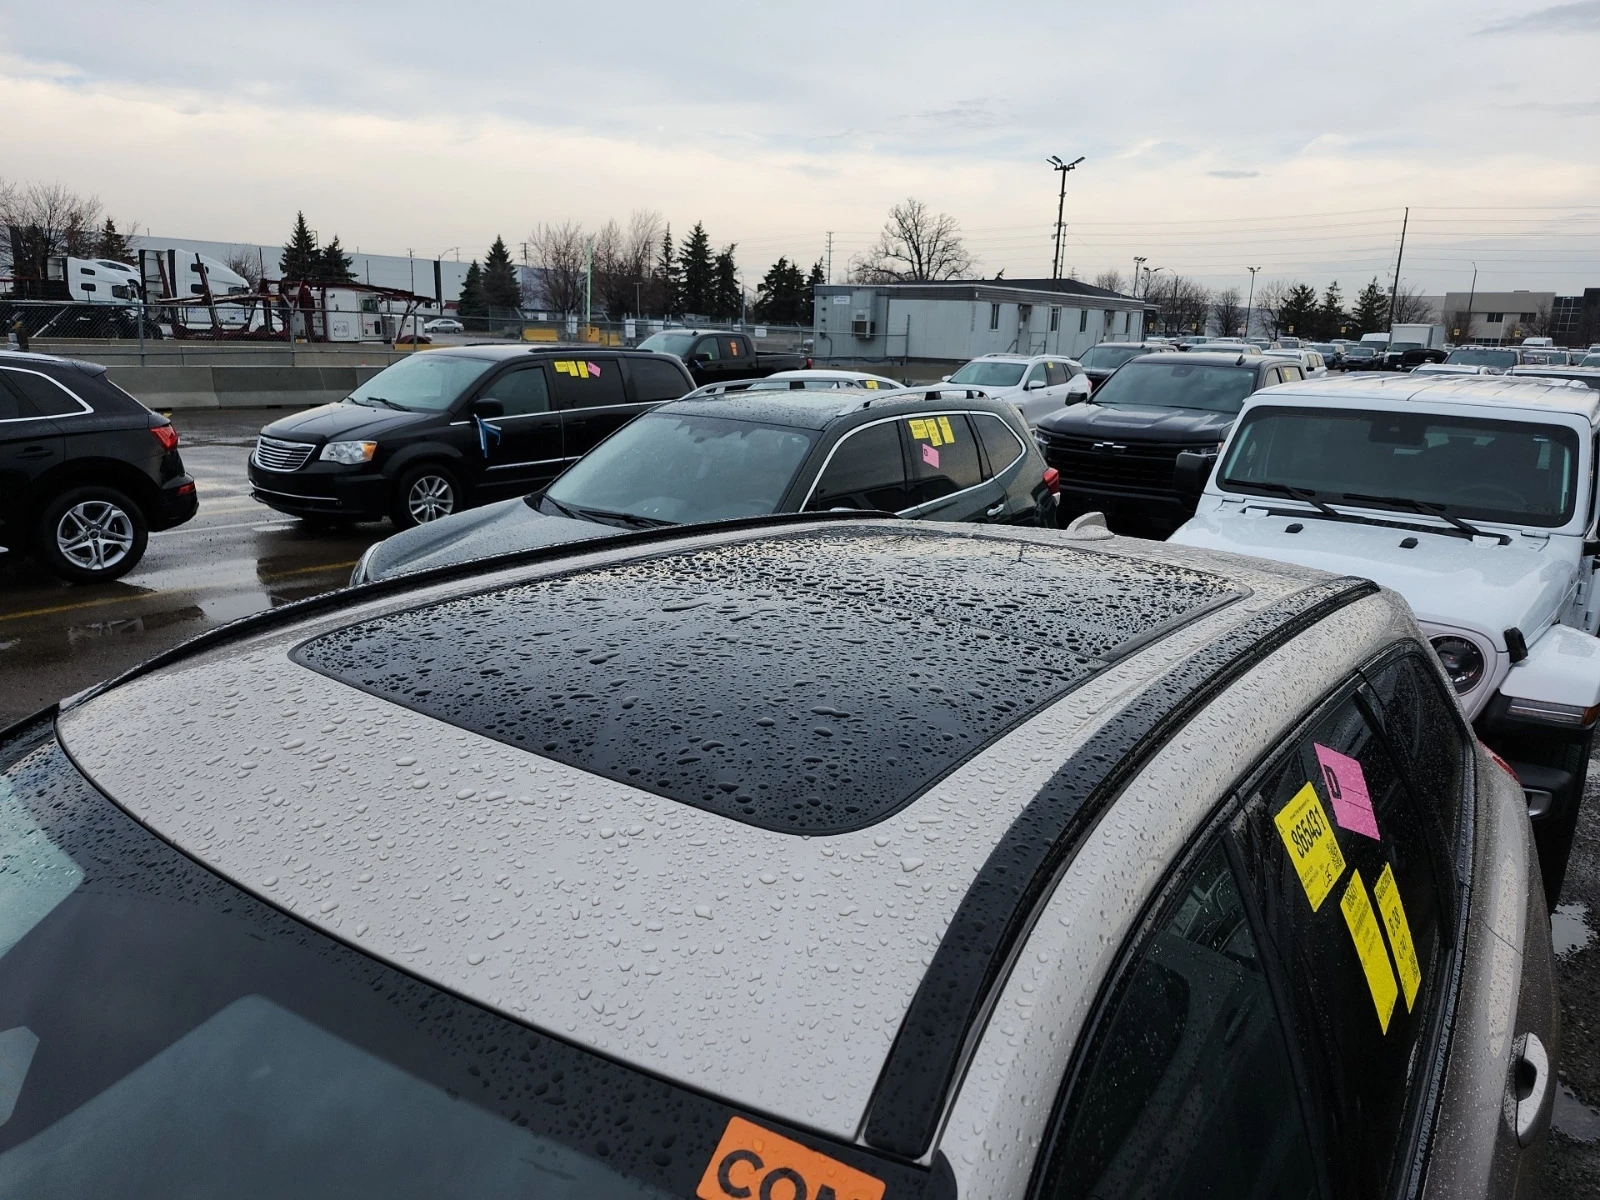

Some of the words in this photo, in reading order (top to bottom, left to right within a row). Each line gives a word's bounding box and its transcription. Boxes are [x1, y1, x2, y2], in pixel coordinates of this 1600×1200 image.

[1323, 764, 1342, 800] D
[1291, 805, 1326, 859] 865431
[717, 1149, 859, 1200] CO
